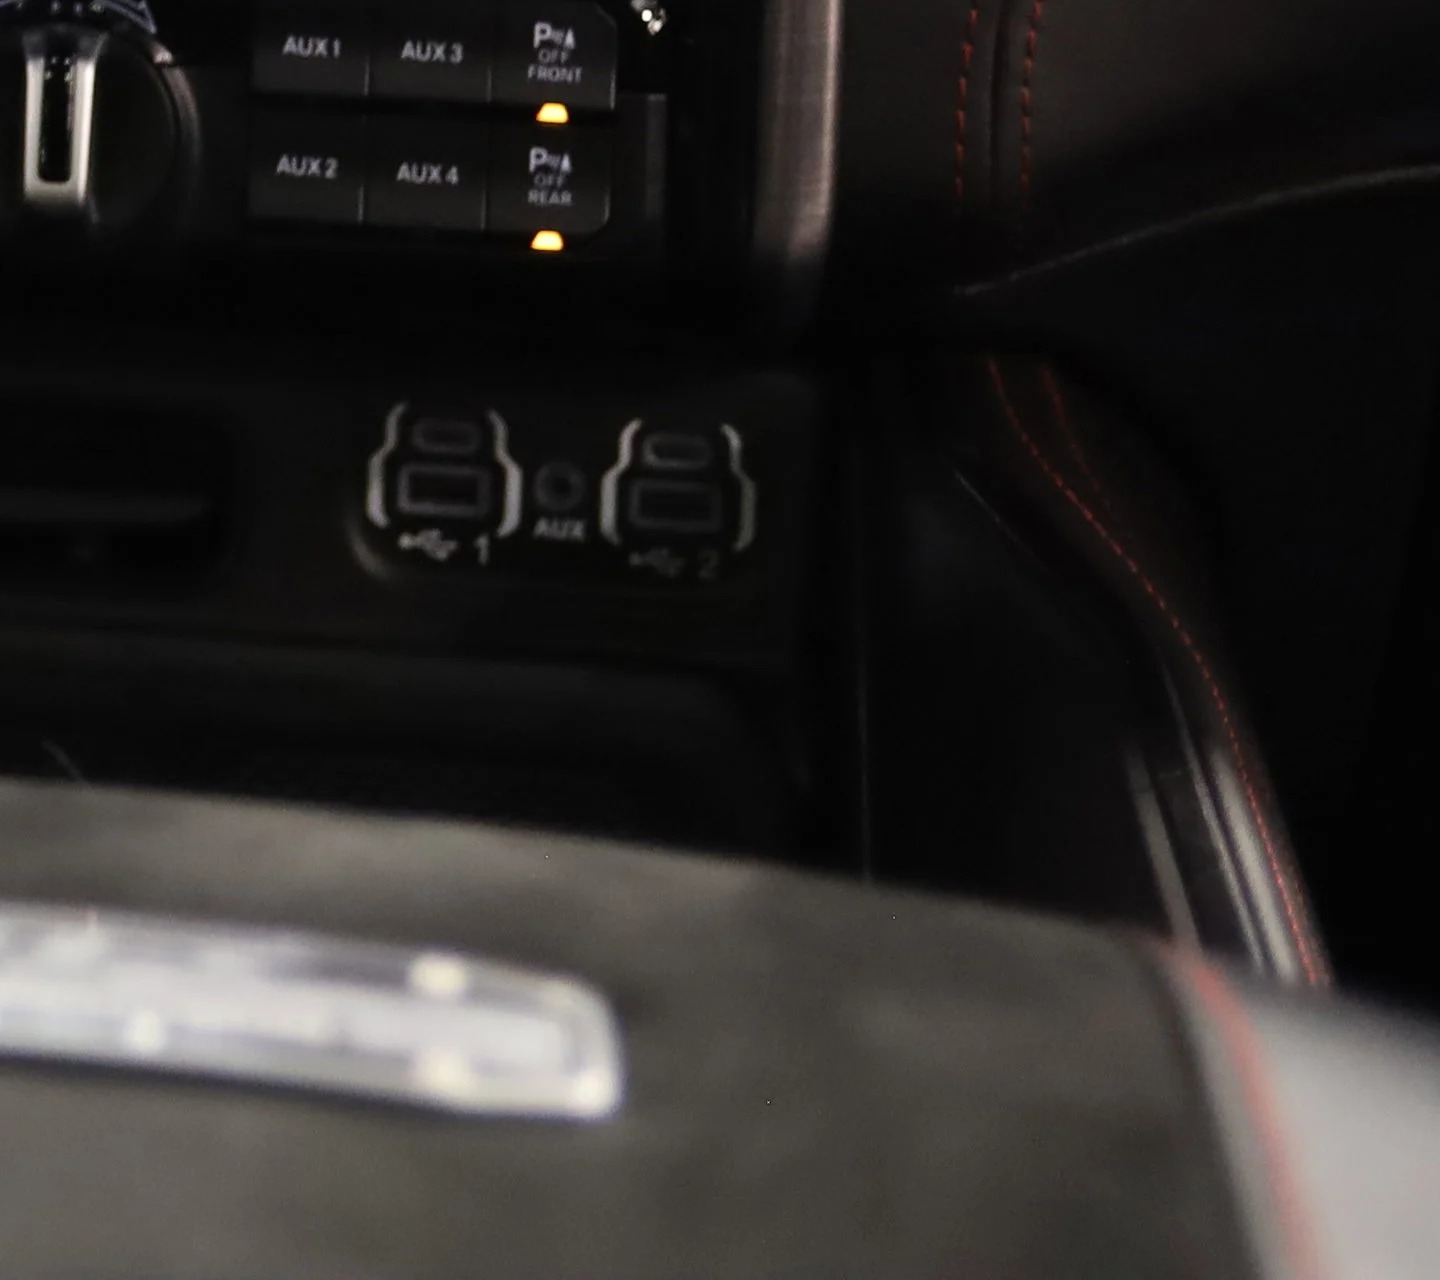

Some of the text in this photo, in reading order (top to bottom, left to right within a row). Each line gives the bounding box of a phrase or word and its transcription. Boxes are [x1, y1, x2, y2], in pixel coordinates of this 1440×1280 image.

[282, 34, 328, 59] AUX
[400, 40, 464, 65] AUX 3
[527, 64, 583, 83] FRONT
[275, 153, 340, 180] AUX 2
[395, 161, 460, 186] AUX 4
[527, 189, 573, 207] REAR
[533, 517, 586, 539] AUX
